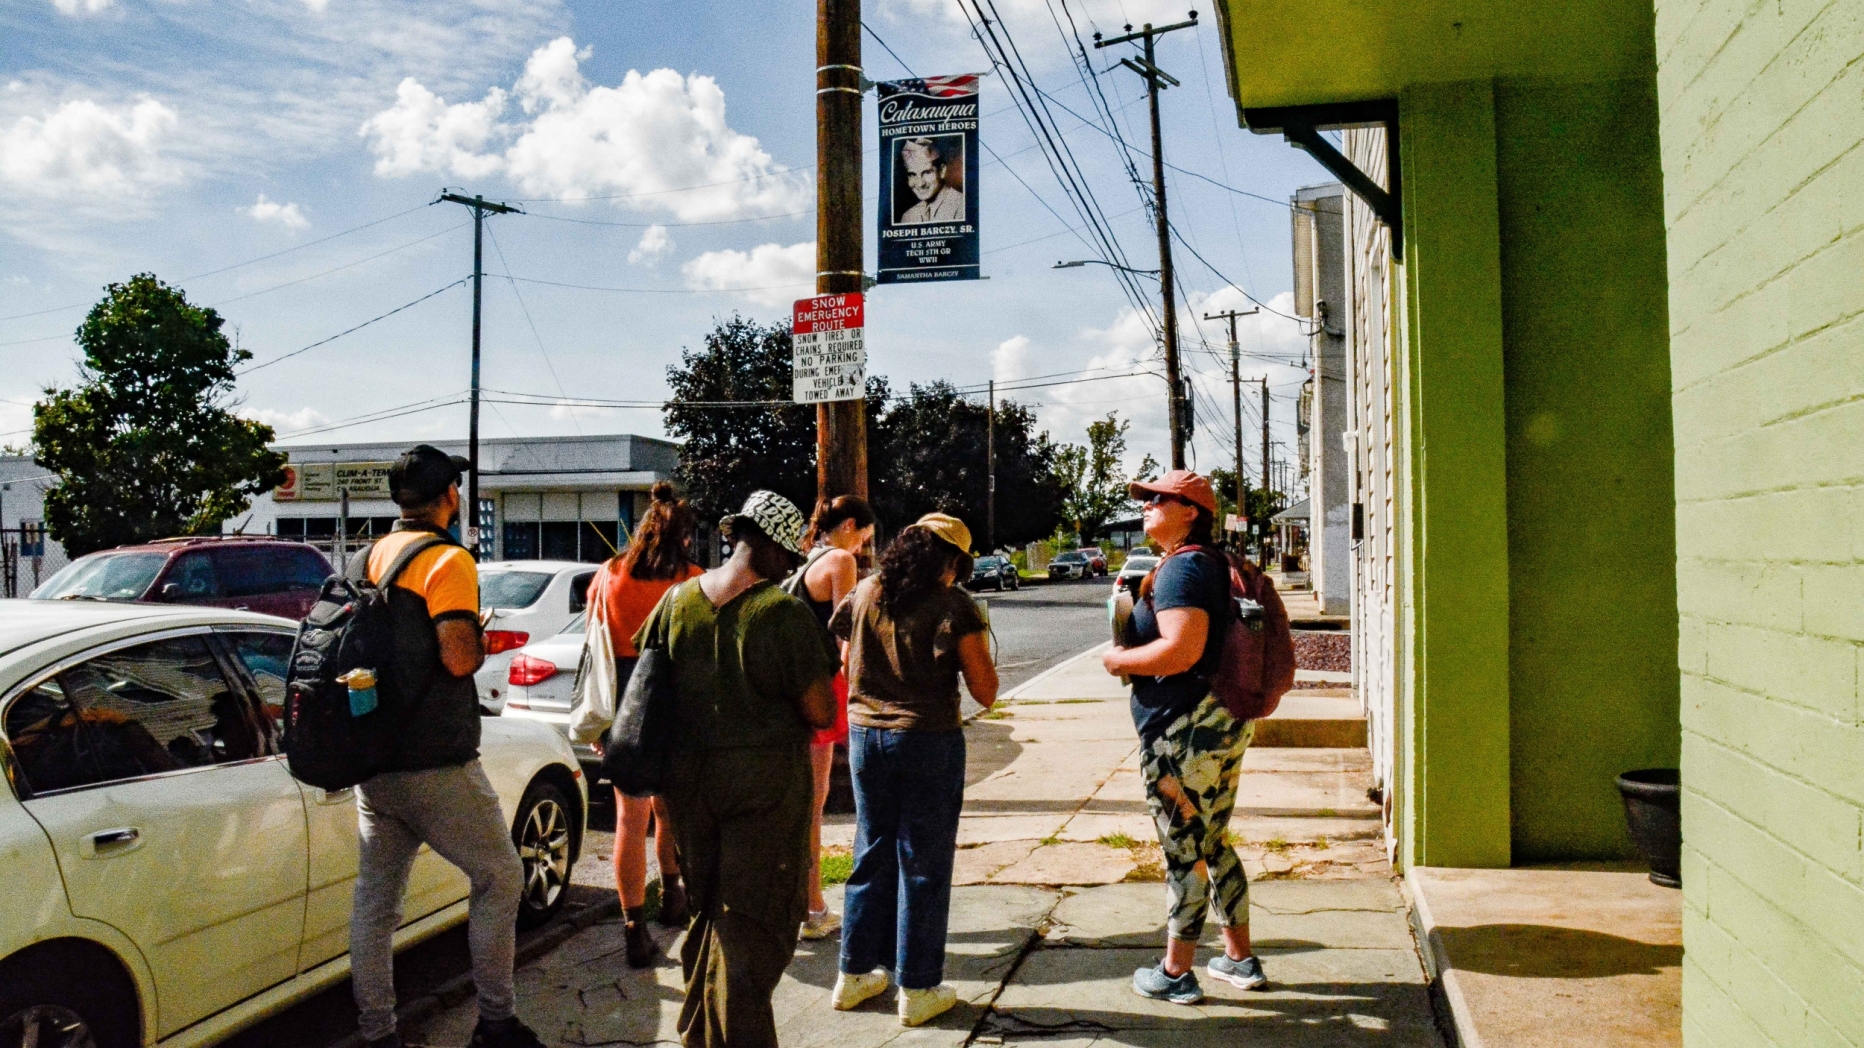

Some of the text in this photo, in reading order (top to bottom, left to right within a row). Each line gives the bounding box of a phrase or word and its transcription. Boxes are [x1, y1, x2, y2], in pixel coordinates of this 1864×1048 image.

[881, 101, 976, 123] Catasauqua
[882, 122, 976, 136] HOMETOWN HEROES
[882, 229, 918, 238] JOSEPH
[959, 225, 975, 233] SR.
[925, 240, 946, 248] ARMY
[897, 272, 932, 280] SAMANTHA
[812, 296, 846, 309] SNOW
[798, 306, 859, 322] EMERGENCY
[812, 319, 845, 332] ROUTE
[798, 329, 861, 344] SNOW TIRES OR
[796, 341, 863, 356] CHAINS REQUIRED
[801, 352, 858, 367] NO PARKING
[795, 368, 819, 379] DURING
[805, 387, 854, 400] TOWED AWAY
[337, 469, 391, 477] CLIM-A-TEM
